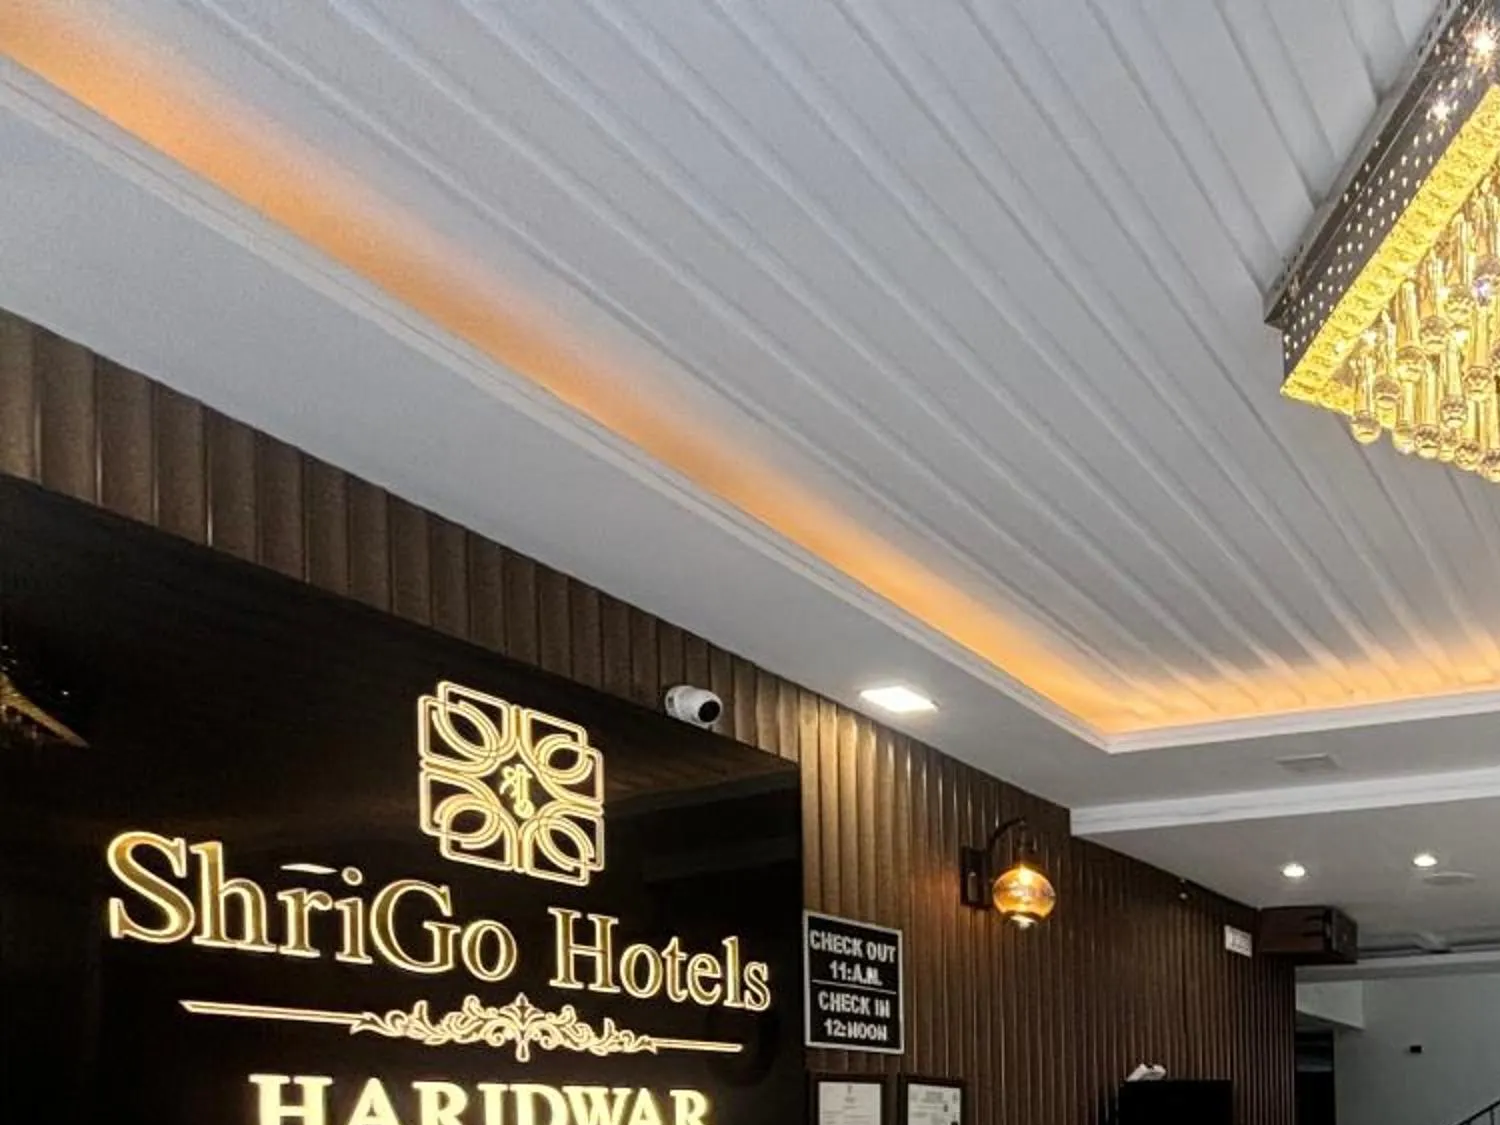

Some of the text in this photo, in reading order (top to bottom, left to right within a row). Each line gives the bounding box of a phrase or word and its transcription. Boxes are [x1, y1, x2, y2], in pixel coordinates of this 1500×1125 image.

[548, 907, 770, 1011] Hotels
[810, 931, 896, 962] CHECK OUT
[818, 990, 890, 1018] CHECK IN
[824, 1018, 887, 1040] 12:NOON
